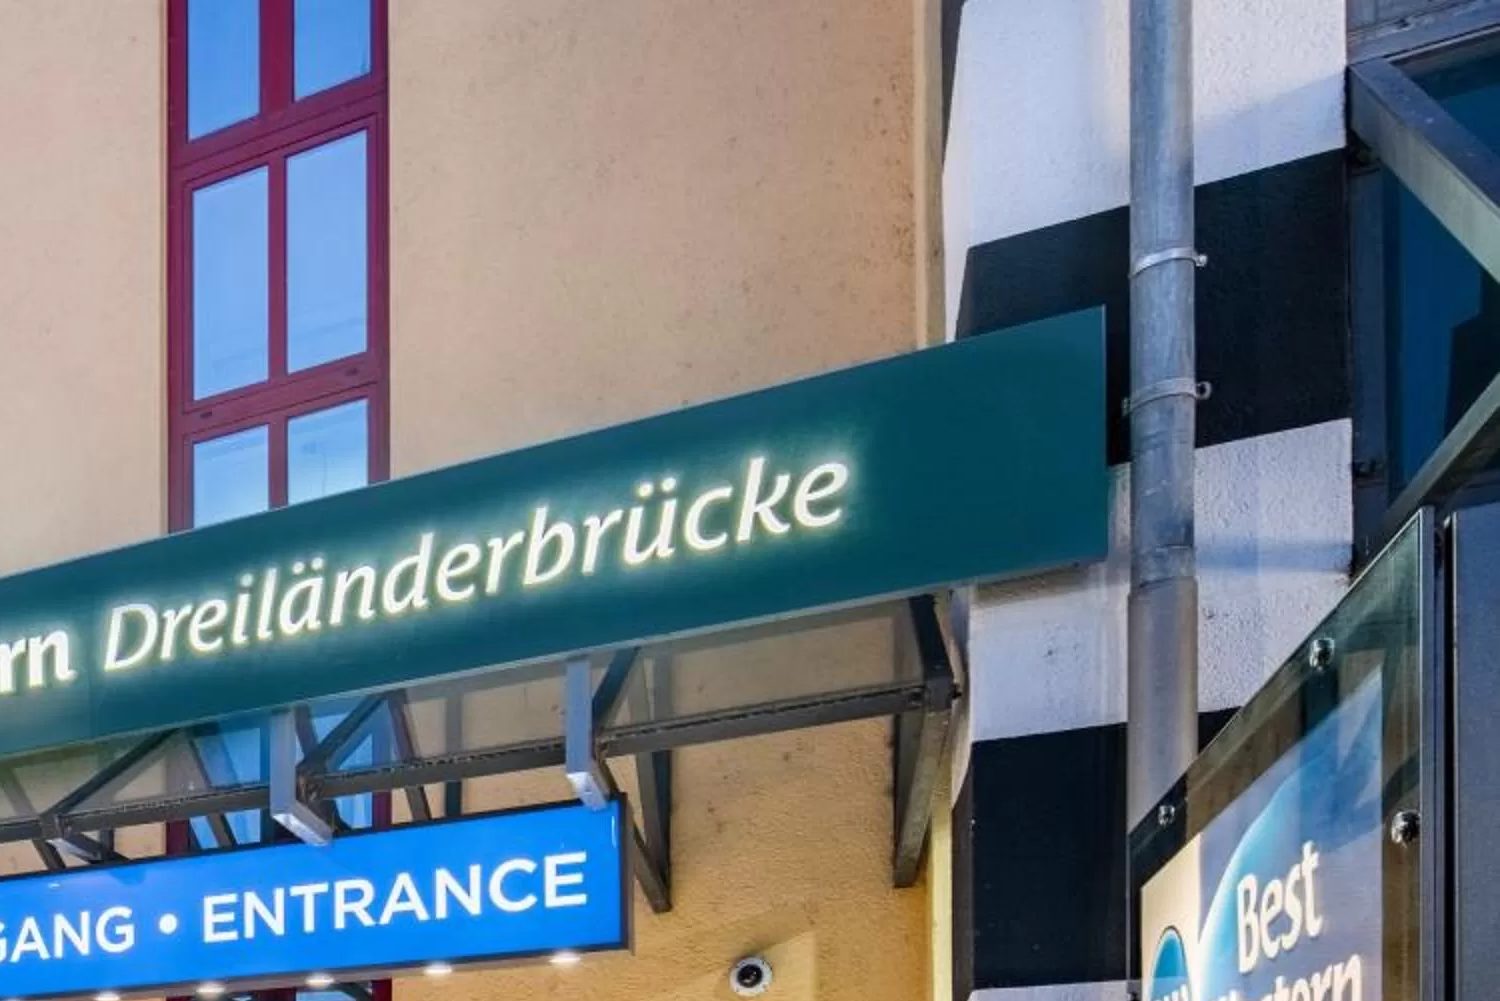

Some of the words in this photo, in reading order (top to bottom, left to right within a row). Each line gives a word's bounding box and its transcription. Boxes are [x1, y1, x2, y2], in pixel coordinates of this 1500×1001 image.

[104, 455, 850, 671] Dreiländerbrücke
[202, 852, 589, 944] ENTRANCE
[1236, 840, 1324, 975] Best
